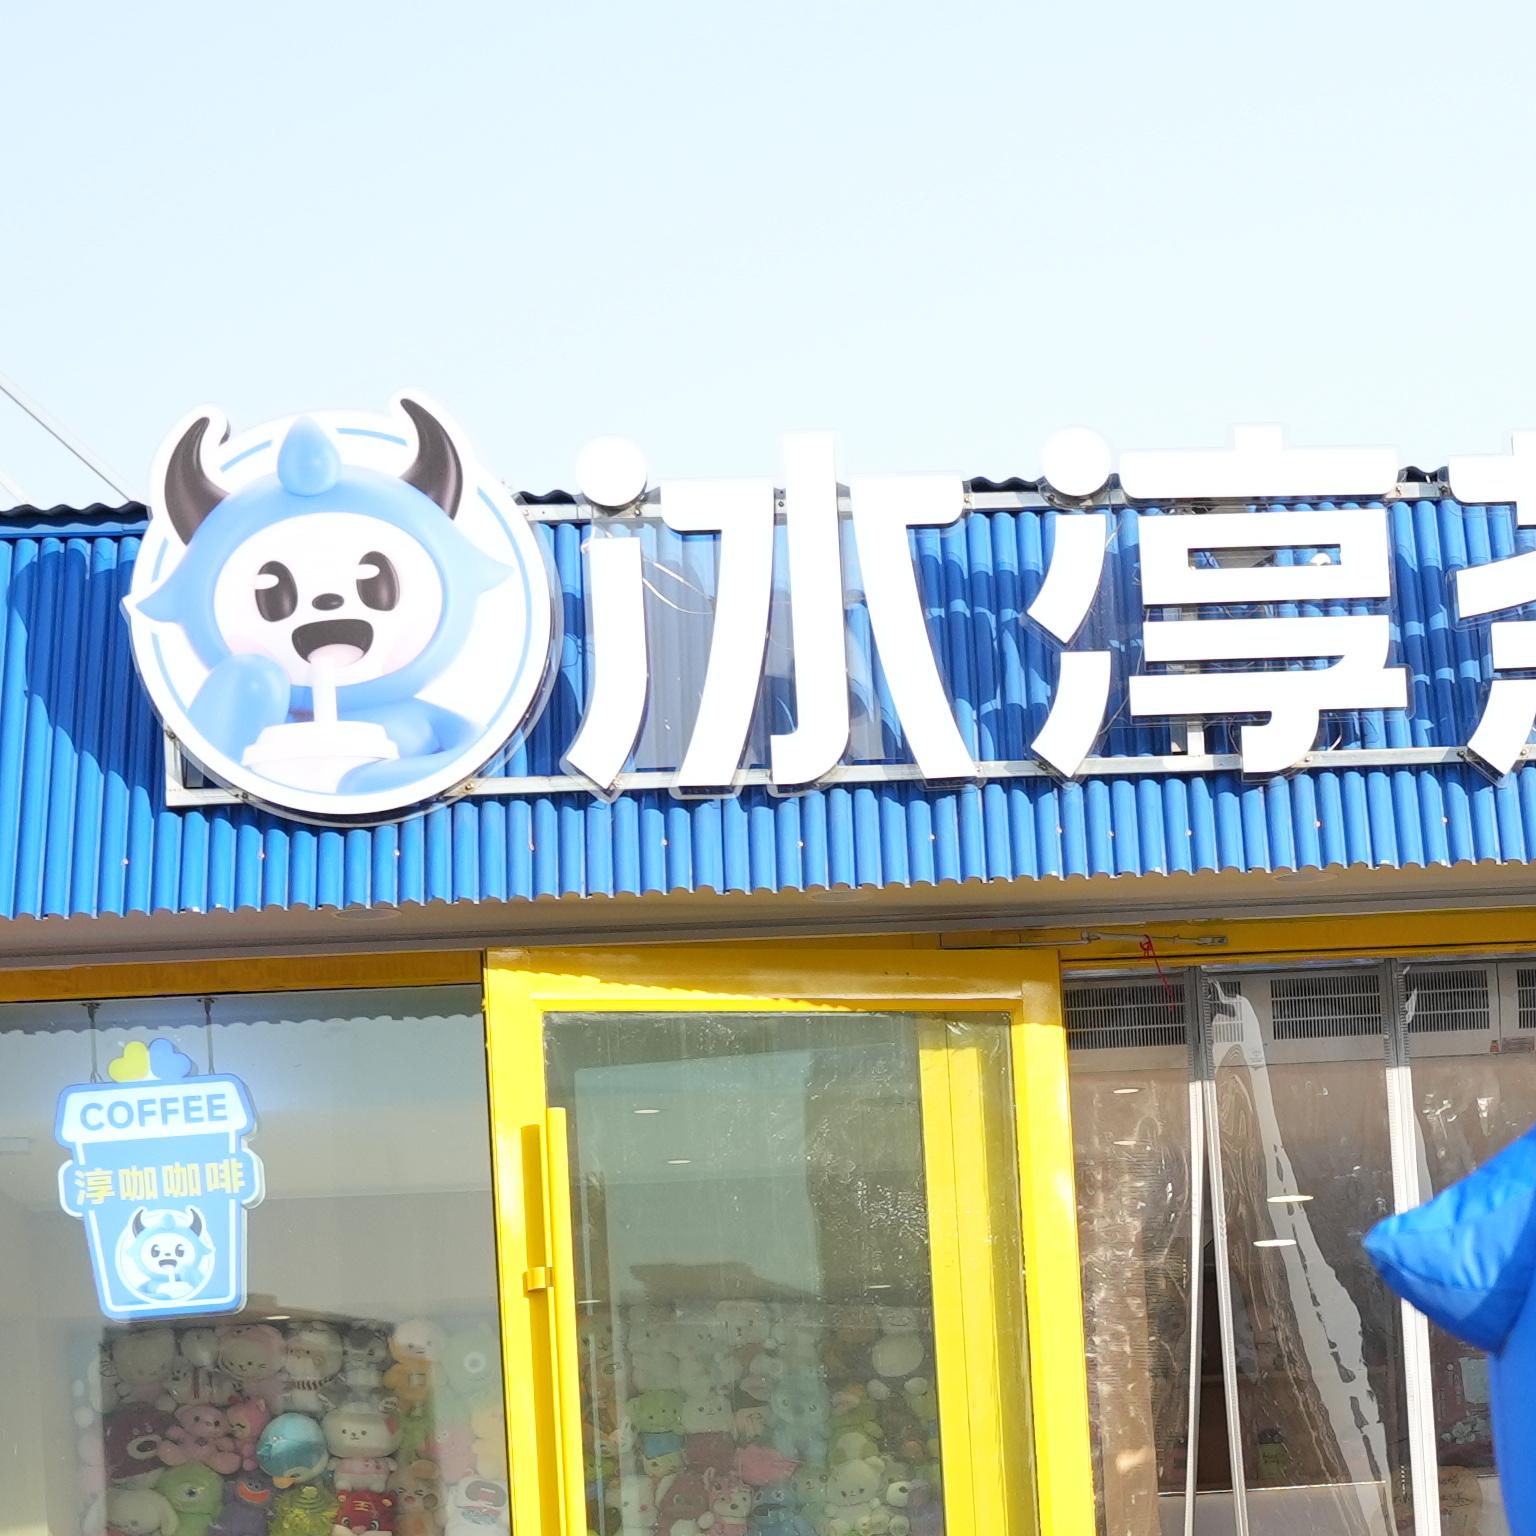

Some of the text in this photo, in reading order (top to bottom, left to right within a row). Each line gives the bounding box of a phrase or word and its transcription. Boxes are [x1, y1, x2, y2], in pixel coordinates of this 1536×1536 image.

[80, 1093, 228, 1131] COFFEE
[75, 1158, 246, 1206] 淳咖咖啡
